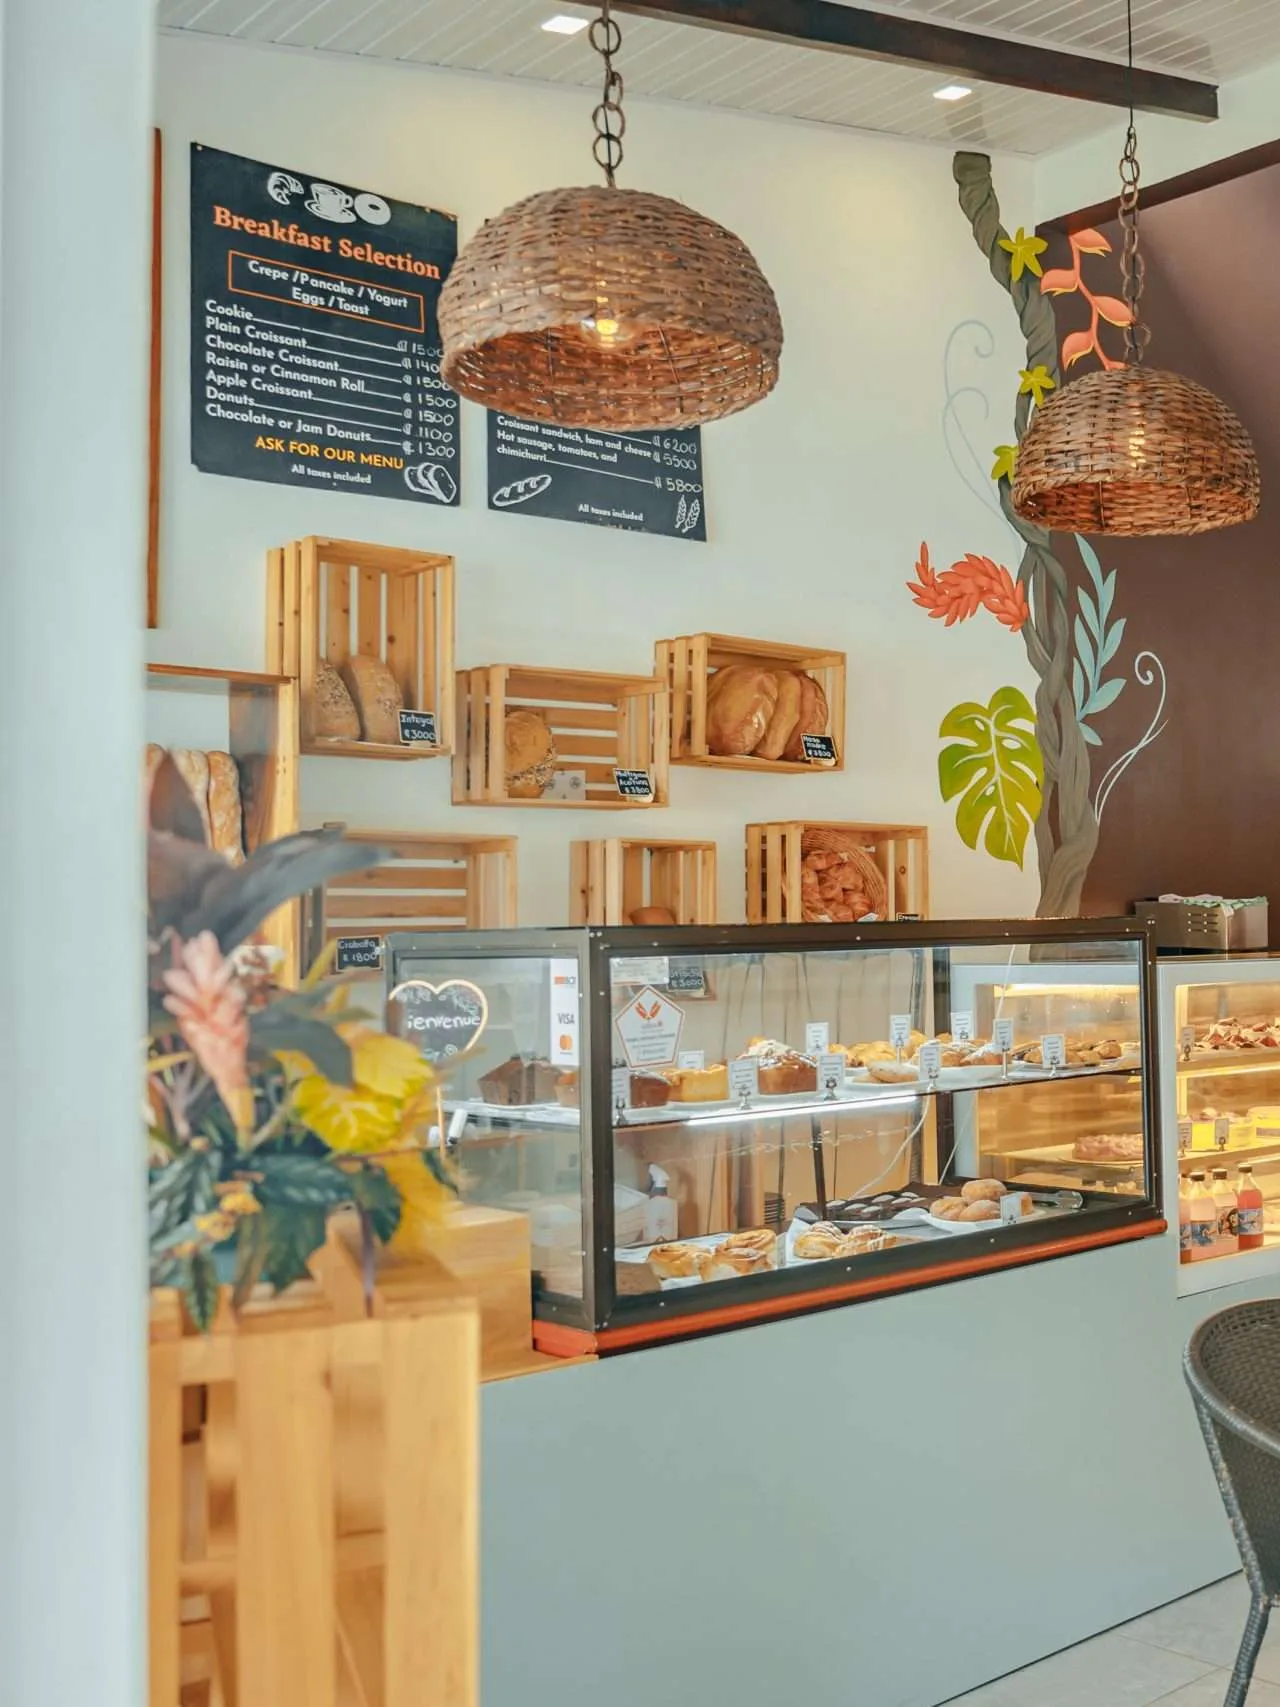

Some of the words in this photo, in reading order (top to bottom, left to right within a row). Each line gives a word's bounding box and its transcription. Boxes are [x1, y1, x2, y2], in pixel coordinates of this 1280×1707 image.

[213, 205, 332, 253] Breakfast
[339, 240, 441, 280] Selection
[248, 260, 289, 283] Crepe
[367, 287, 408, 308] Yogurt
[292, 287, 325, 306] Eggs
[205, 299, 253, 321] Cookie
[205, 316, 241, 334] Plain
[244, 323, 307, 349] Croissant
[205, 334, 276, 359] Chocolate
[279, 349, 340, 372] Croissant
[205, 351, 249, 371] Raisin
[251, 362, 267, 375] or
[270, 364, 337, 389] Cinnamon
[341, 377, 366, 393] Roll
[205, 368, 249, 389] Apple
[251, 378, 313, 400] Croissant
[205, 386, 256, 406] Donuts
[205, 404, 276, 427] Chocolate
[278, 416, 294, 429] or
[297, 420, 323, 436] Jam
[327, 425, 373, 443] Donuts
[497, 416, 539, 433] Croissant
[585, 434, 603, 448] ham
[605, 438, 622, 450] and
[624, 444, 652, 458] cheese
[255, 435, 284, 452] ASK
[289, 442, 321, 458] FOR
[323, 447, 356, 464] OUR
[360, 454, 404, 470] MENU
[497, 430, 515, 442] Hot
[601, 450, 617, 463] and
[291, 463, 304, 475] All
[306, 466, 331, 480] taxes
[333, 469, 372, 484] included
[578, 503, 589, 513] All
[612, 508, 644, 521] included
[407, 1015, 481, 1030] ienvenue
[556, 1013, 576, 1025] VISA
